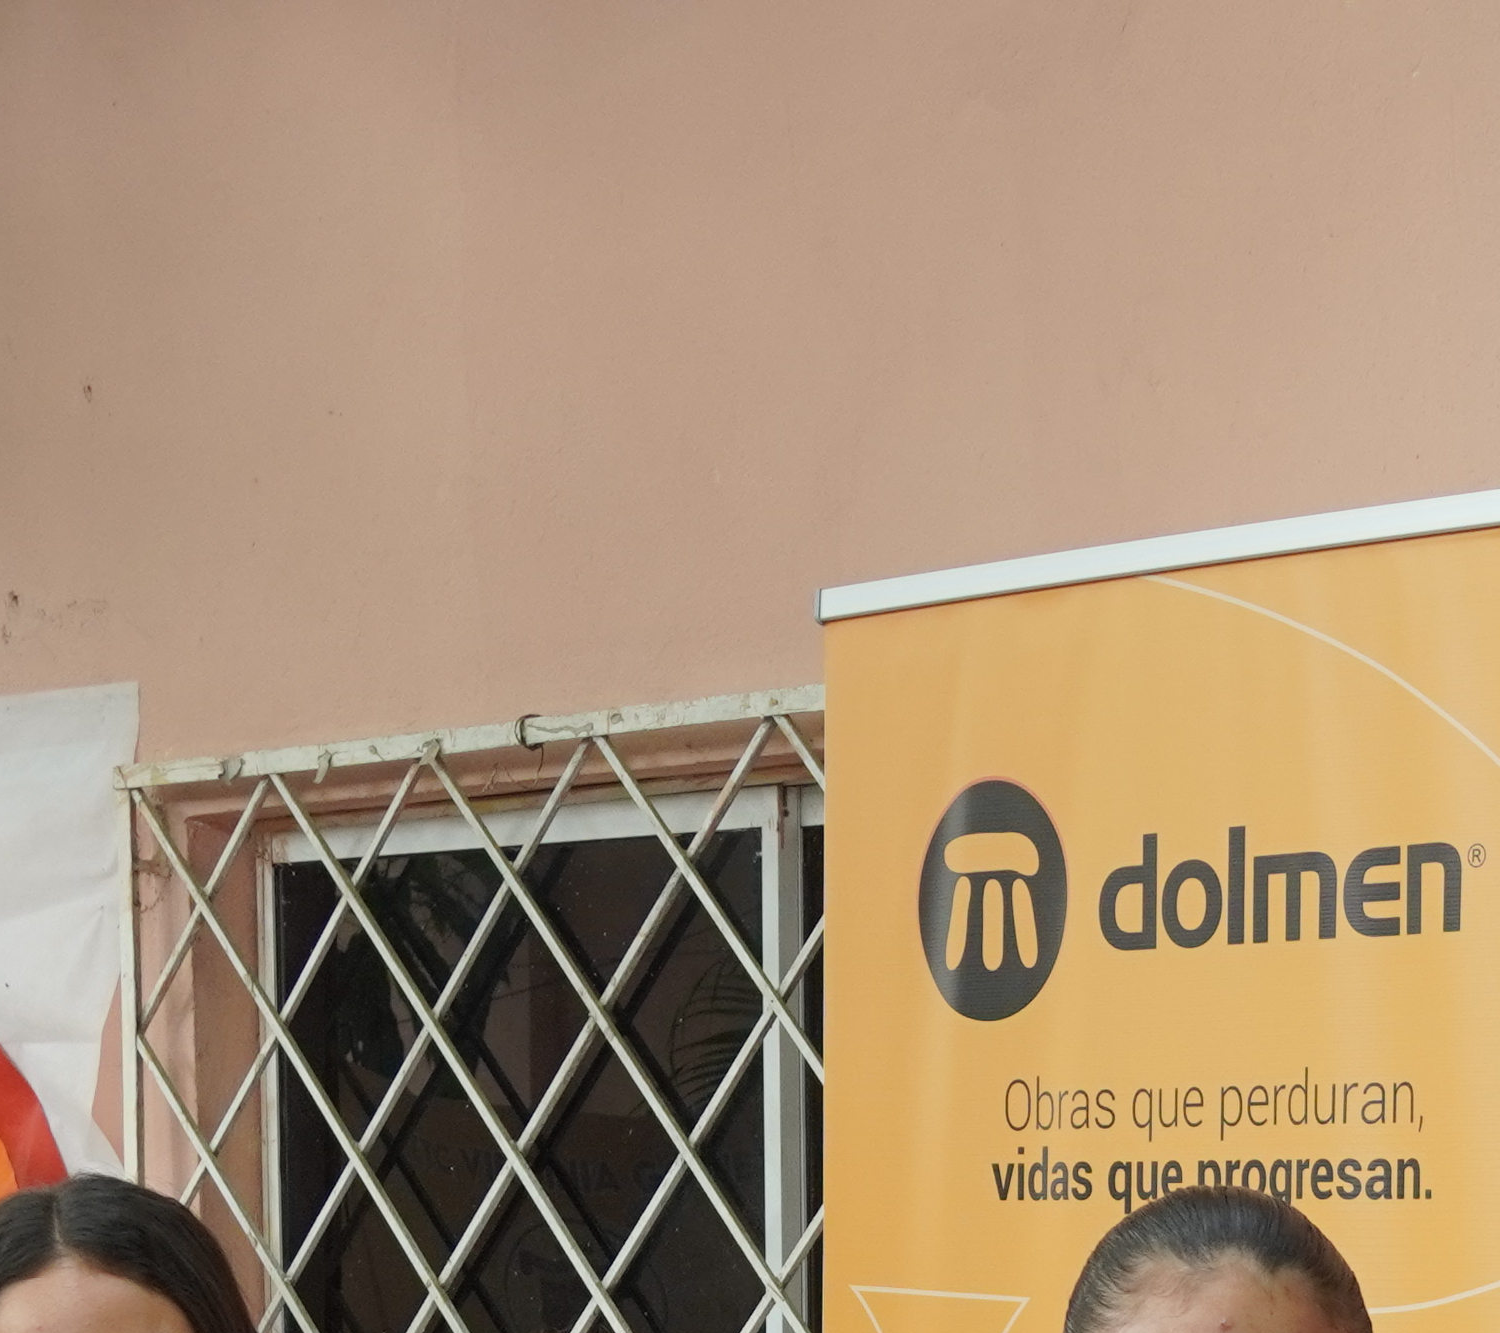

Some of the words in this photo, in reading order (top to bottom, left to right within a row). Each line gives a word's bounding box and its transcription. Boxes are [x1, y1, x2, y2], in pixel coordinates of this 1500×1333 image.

[1004, 1076, 1116, 1132] Obras
[1132, 1086, 1204, 1143] que
[1219, 1066, 1424, 1142] perduran,
[992, 1146, 1093, 1202] vidas
[1107, 1158, 1184, 1215] que
